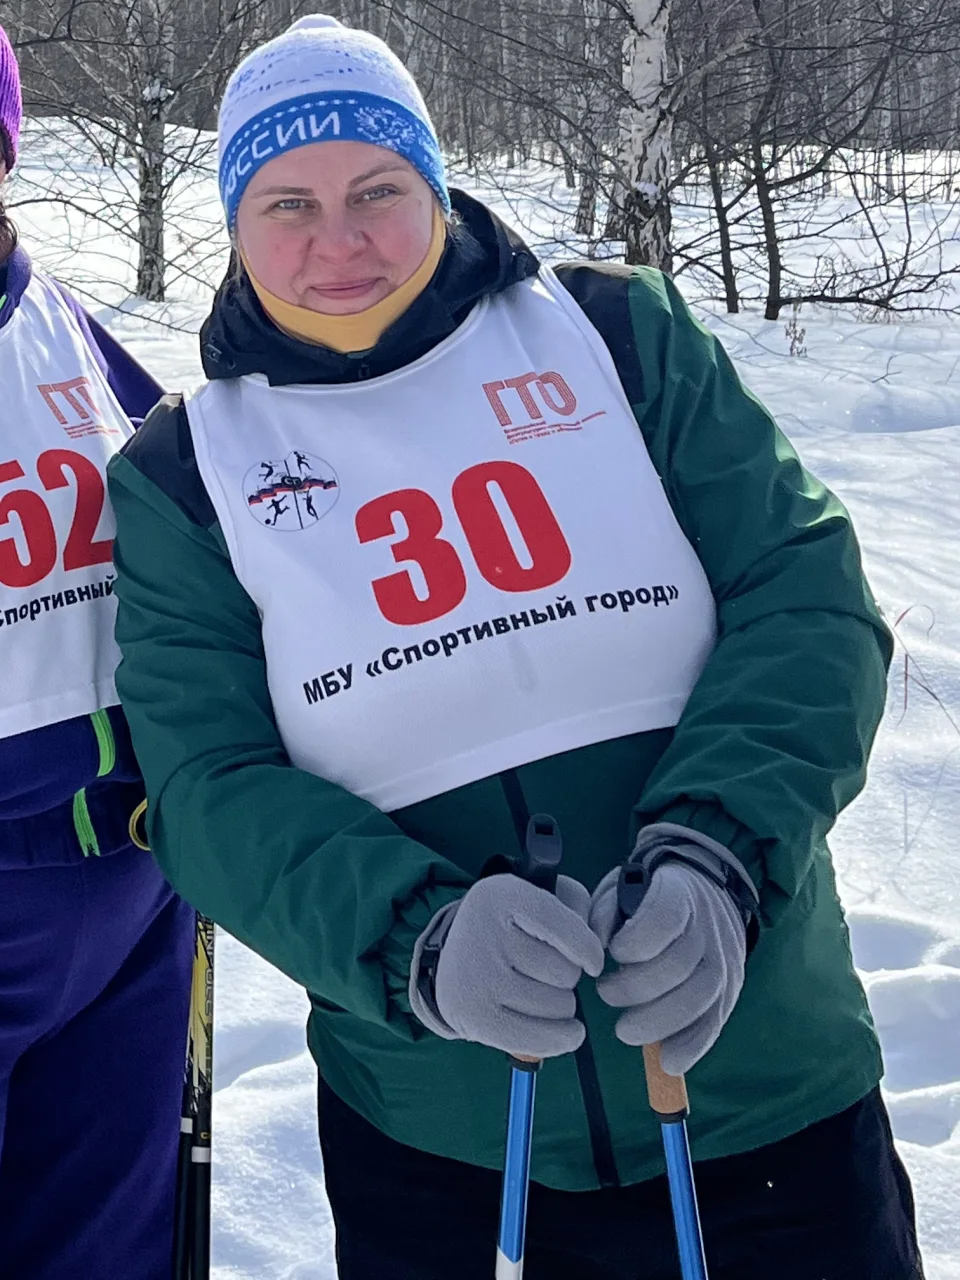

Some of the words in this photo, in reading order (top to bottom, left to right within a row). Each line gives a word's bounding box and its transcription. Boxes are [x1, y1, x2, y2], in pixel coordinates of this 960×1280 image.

[482, 371, 577, 427] ГТО
[354, 460, 572, 627] 30
[302, 663, 353, 705] МБУ
[365, 595, 577, 678] «Спортивный
[584, 584, 679, 613] город»
